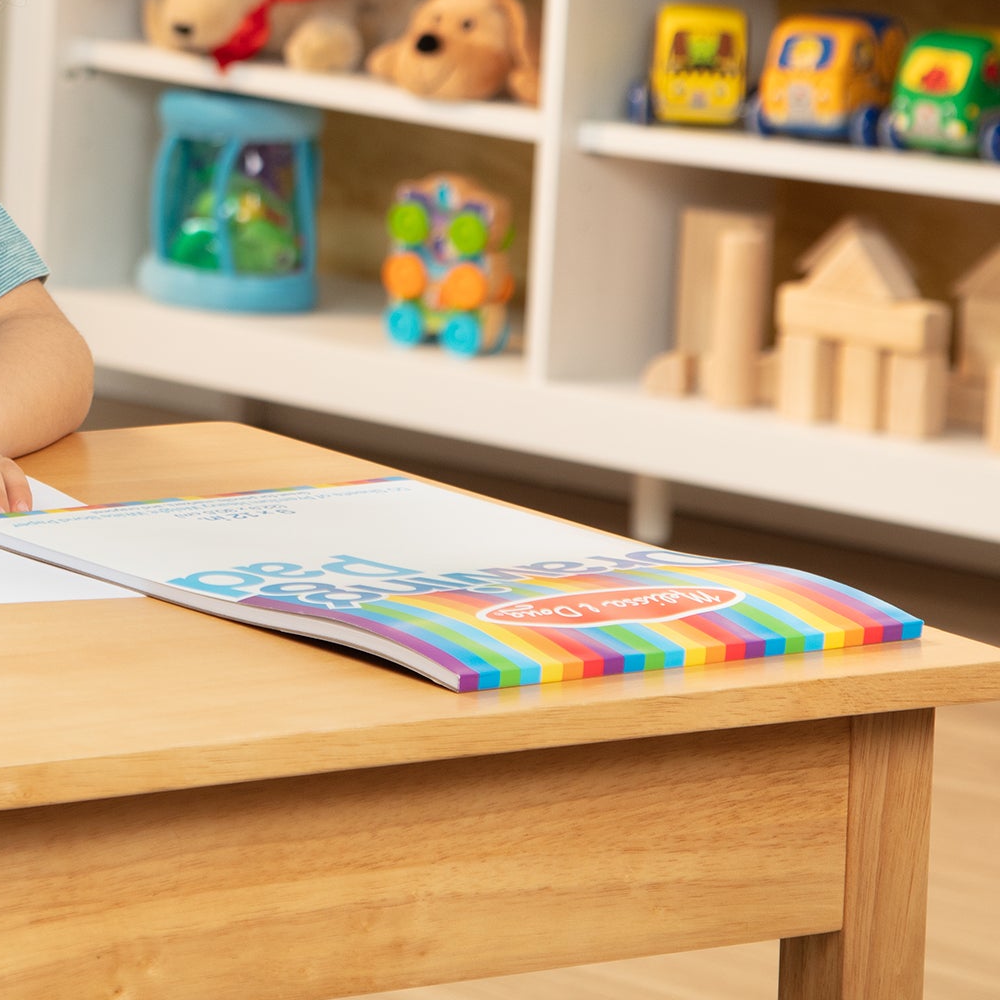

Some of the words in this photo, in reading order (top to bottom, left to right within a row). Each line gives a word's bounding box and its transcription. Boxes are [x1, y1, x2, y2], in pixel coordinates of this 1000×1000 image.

[166, 554, 424, 598] Pad
[258, 550, 745, 609] Drawing
[579, 602, 600, 615] &
[601, 588, 721, 609] Melissa
[501, 604, 582, 619] Doug
